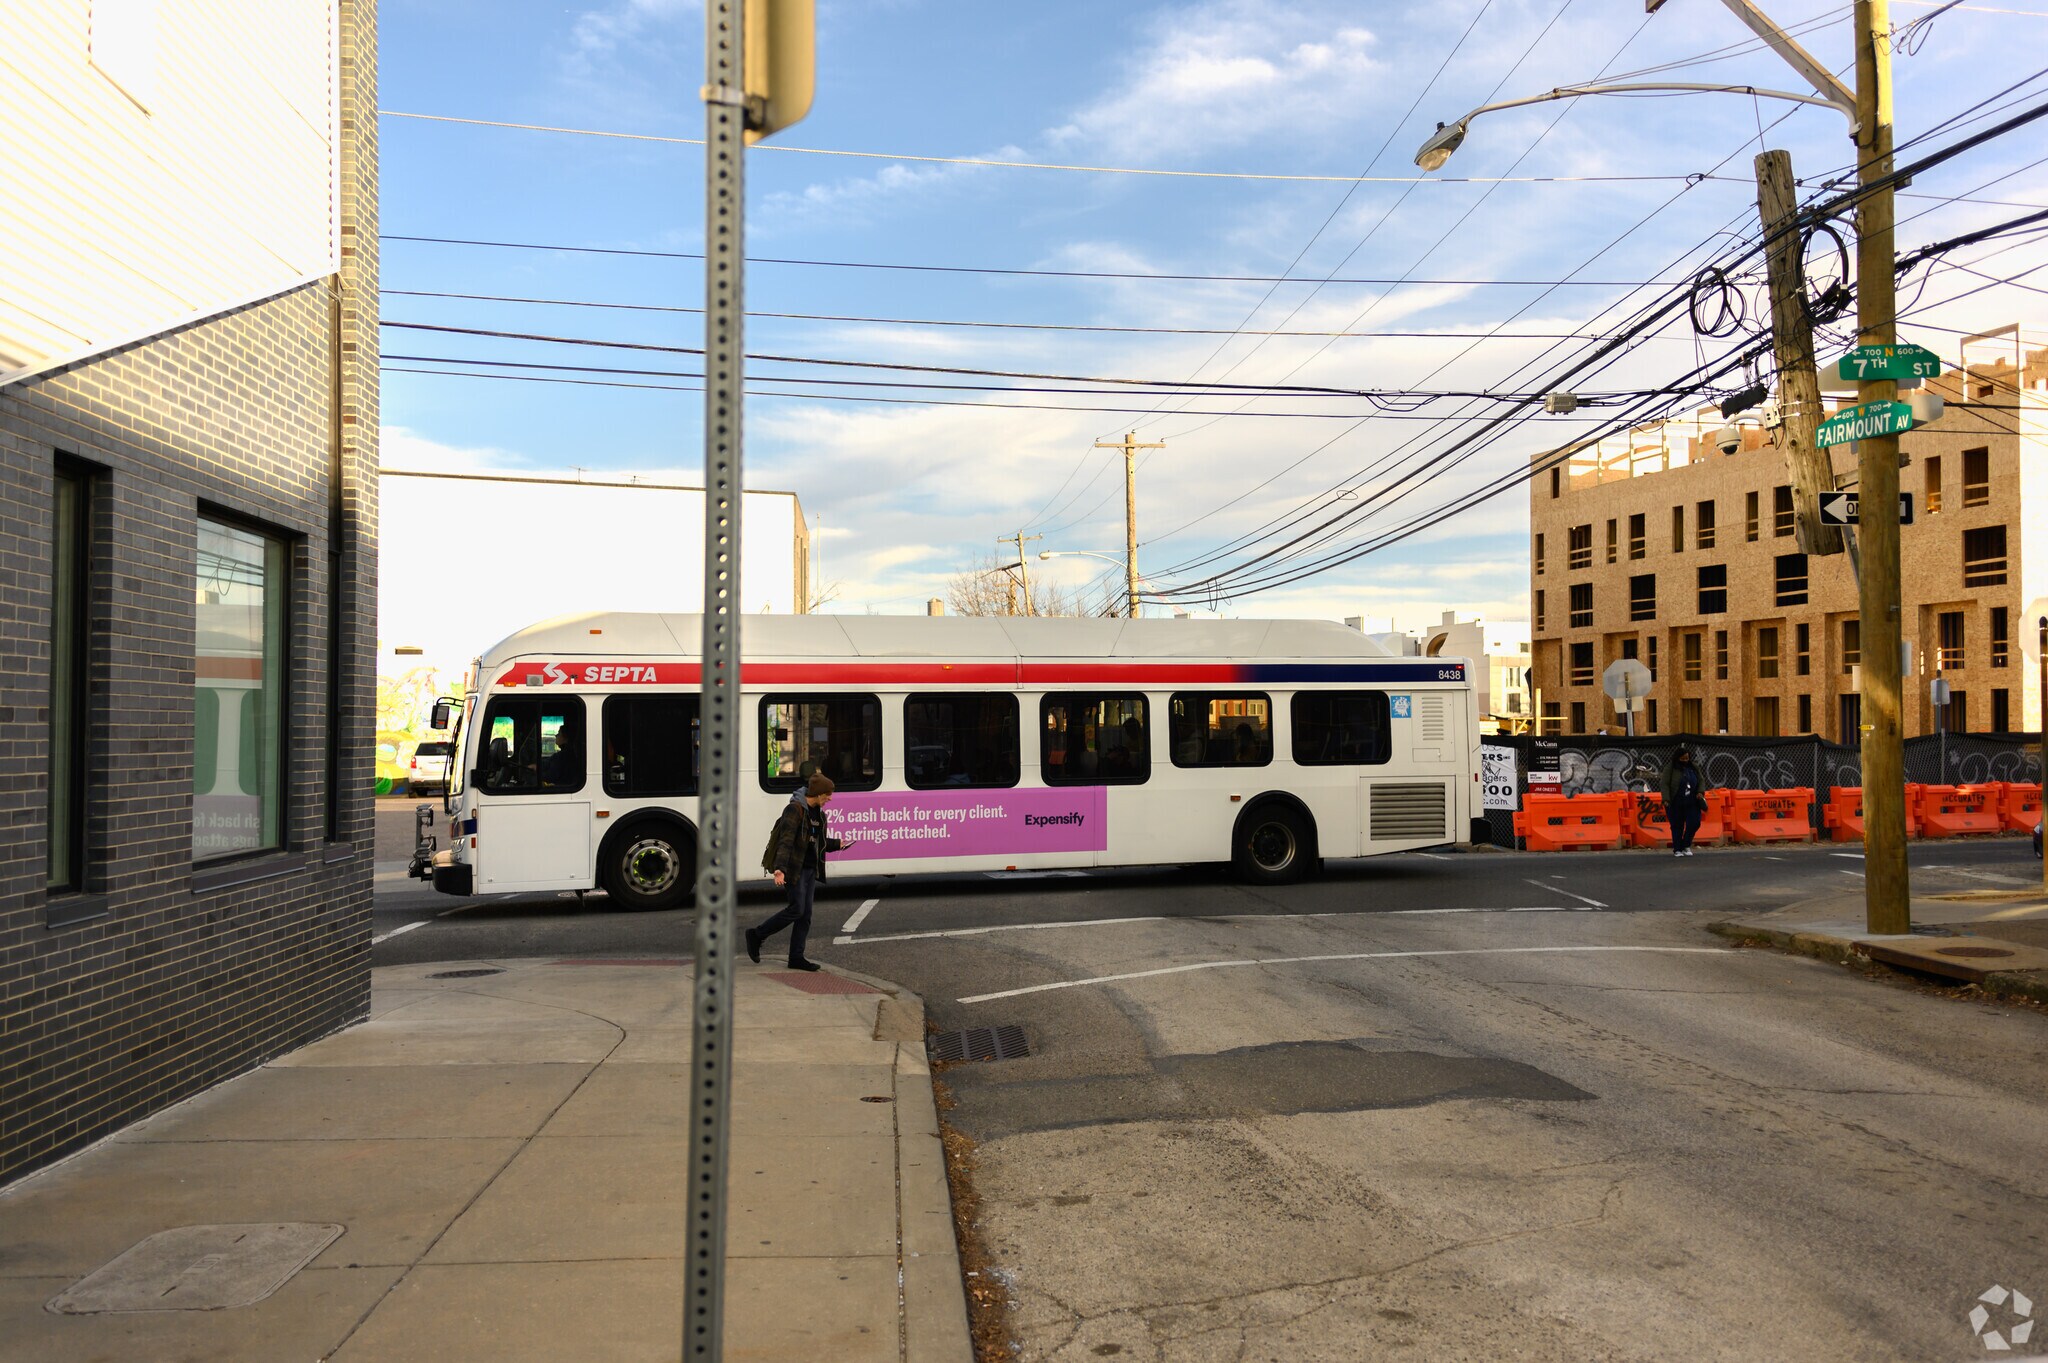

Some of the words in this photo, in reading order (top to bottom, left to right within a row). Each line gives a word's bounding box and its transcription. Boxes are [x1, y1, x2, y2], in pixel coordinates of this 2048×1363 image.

[1884, 347, 1894, 357] N
[1897, 347, 1914, 355] 600
[1913, 362, 1933, 376] ST
[1842, 410, 1855, 420] 600
[1857, 407, 1866, 417] W
[1869, 405, 1882, 414] 700
[1817, 413, 1892, 447] FAIRMOUNT
[1896, 414, 1909, 430] AV
[584, 666, 657, 683] SEPTA
[1438, 669, 1461, 680] 8438
[1548, 773, 1559, 781] kw
[825, 807, 845, 824] 2%
[847, 807, 877, 823] cash
[879, 806, 910, 822] back
[913, 806, 931, 821] for
[934, 808, 966, 824] every
[969, 804, 1008, 819] client.
[1024, 811, 1085, 828] Expensify
[845, 826, 890, 844] strings
[891, 823, 951, 840] attached.
